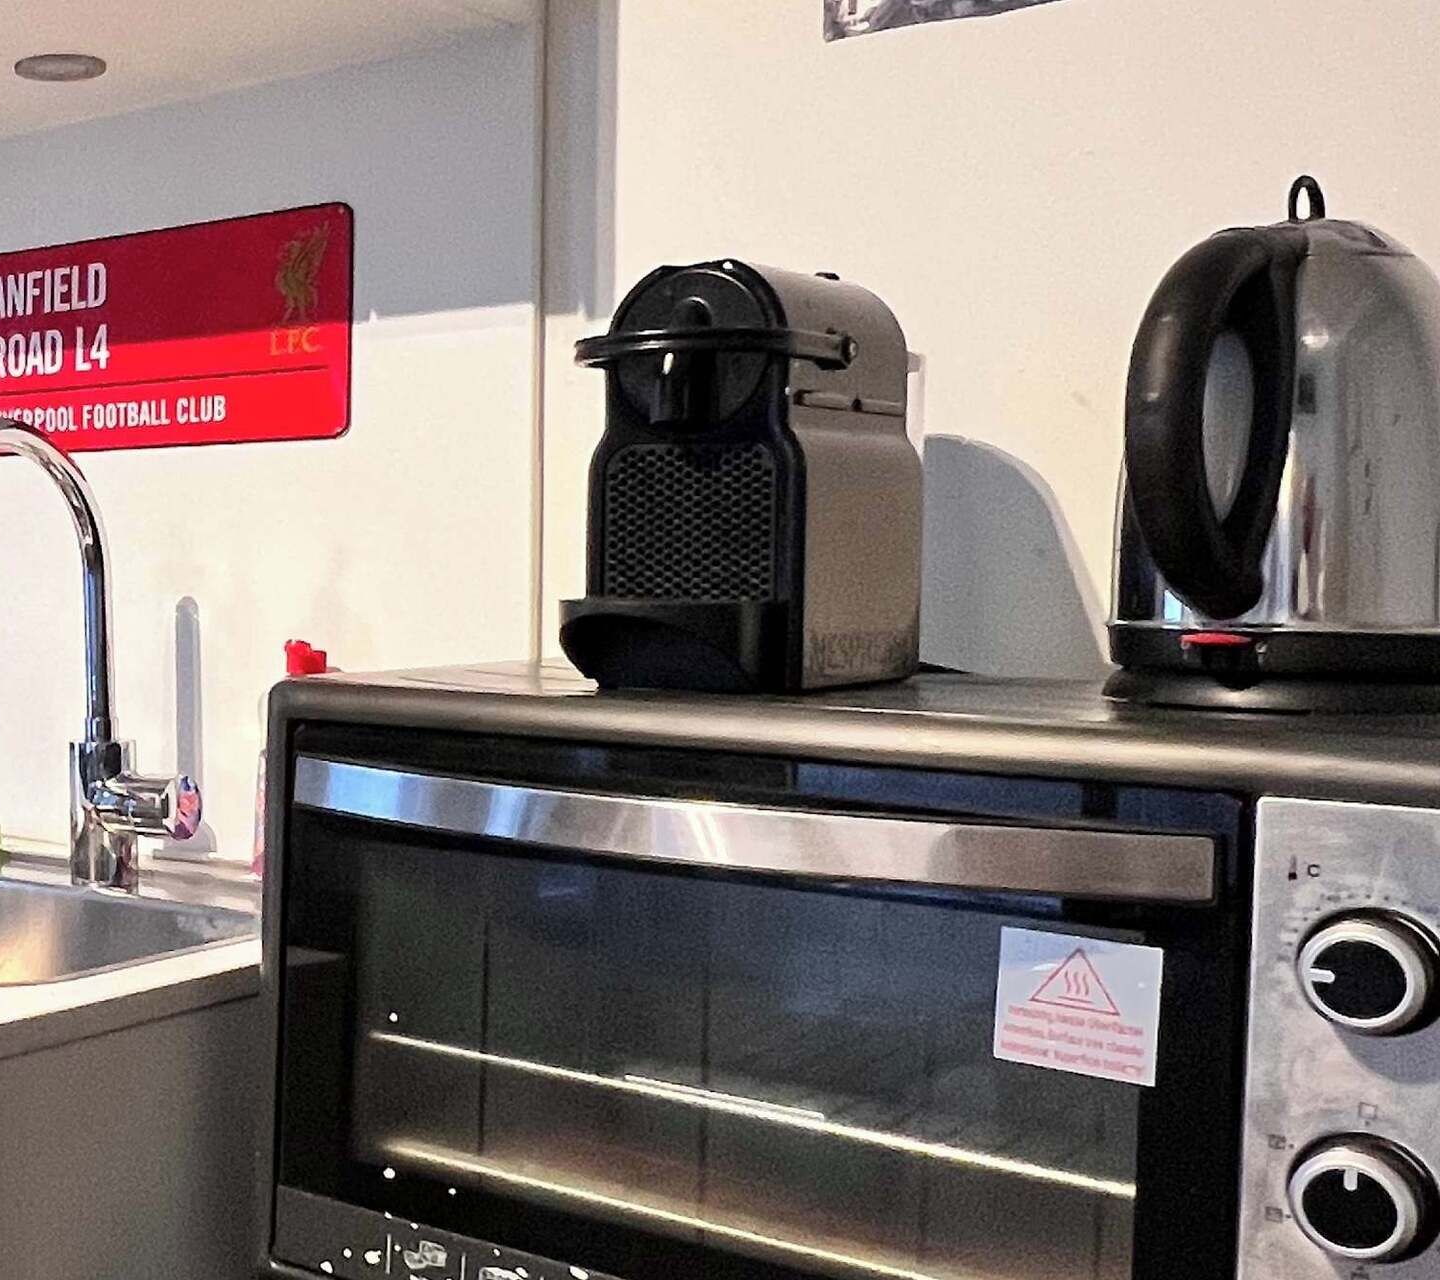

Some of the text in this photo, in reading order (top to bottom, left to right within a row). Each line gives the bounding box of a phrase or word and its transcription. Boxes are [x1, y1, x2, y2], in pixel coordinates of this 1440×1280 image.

[75, 323, 111, 373] L4
[270, 325, 323, 356] LFC
[81, 398, 171, 431] FOOTBALL
[176, 394, 227, 425] CLUB
